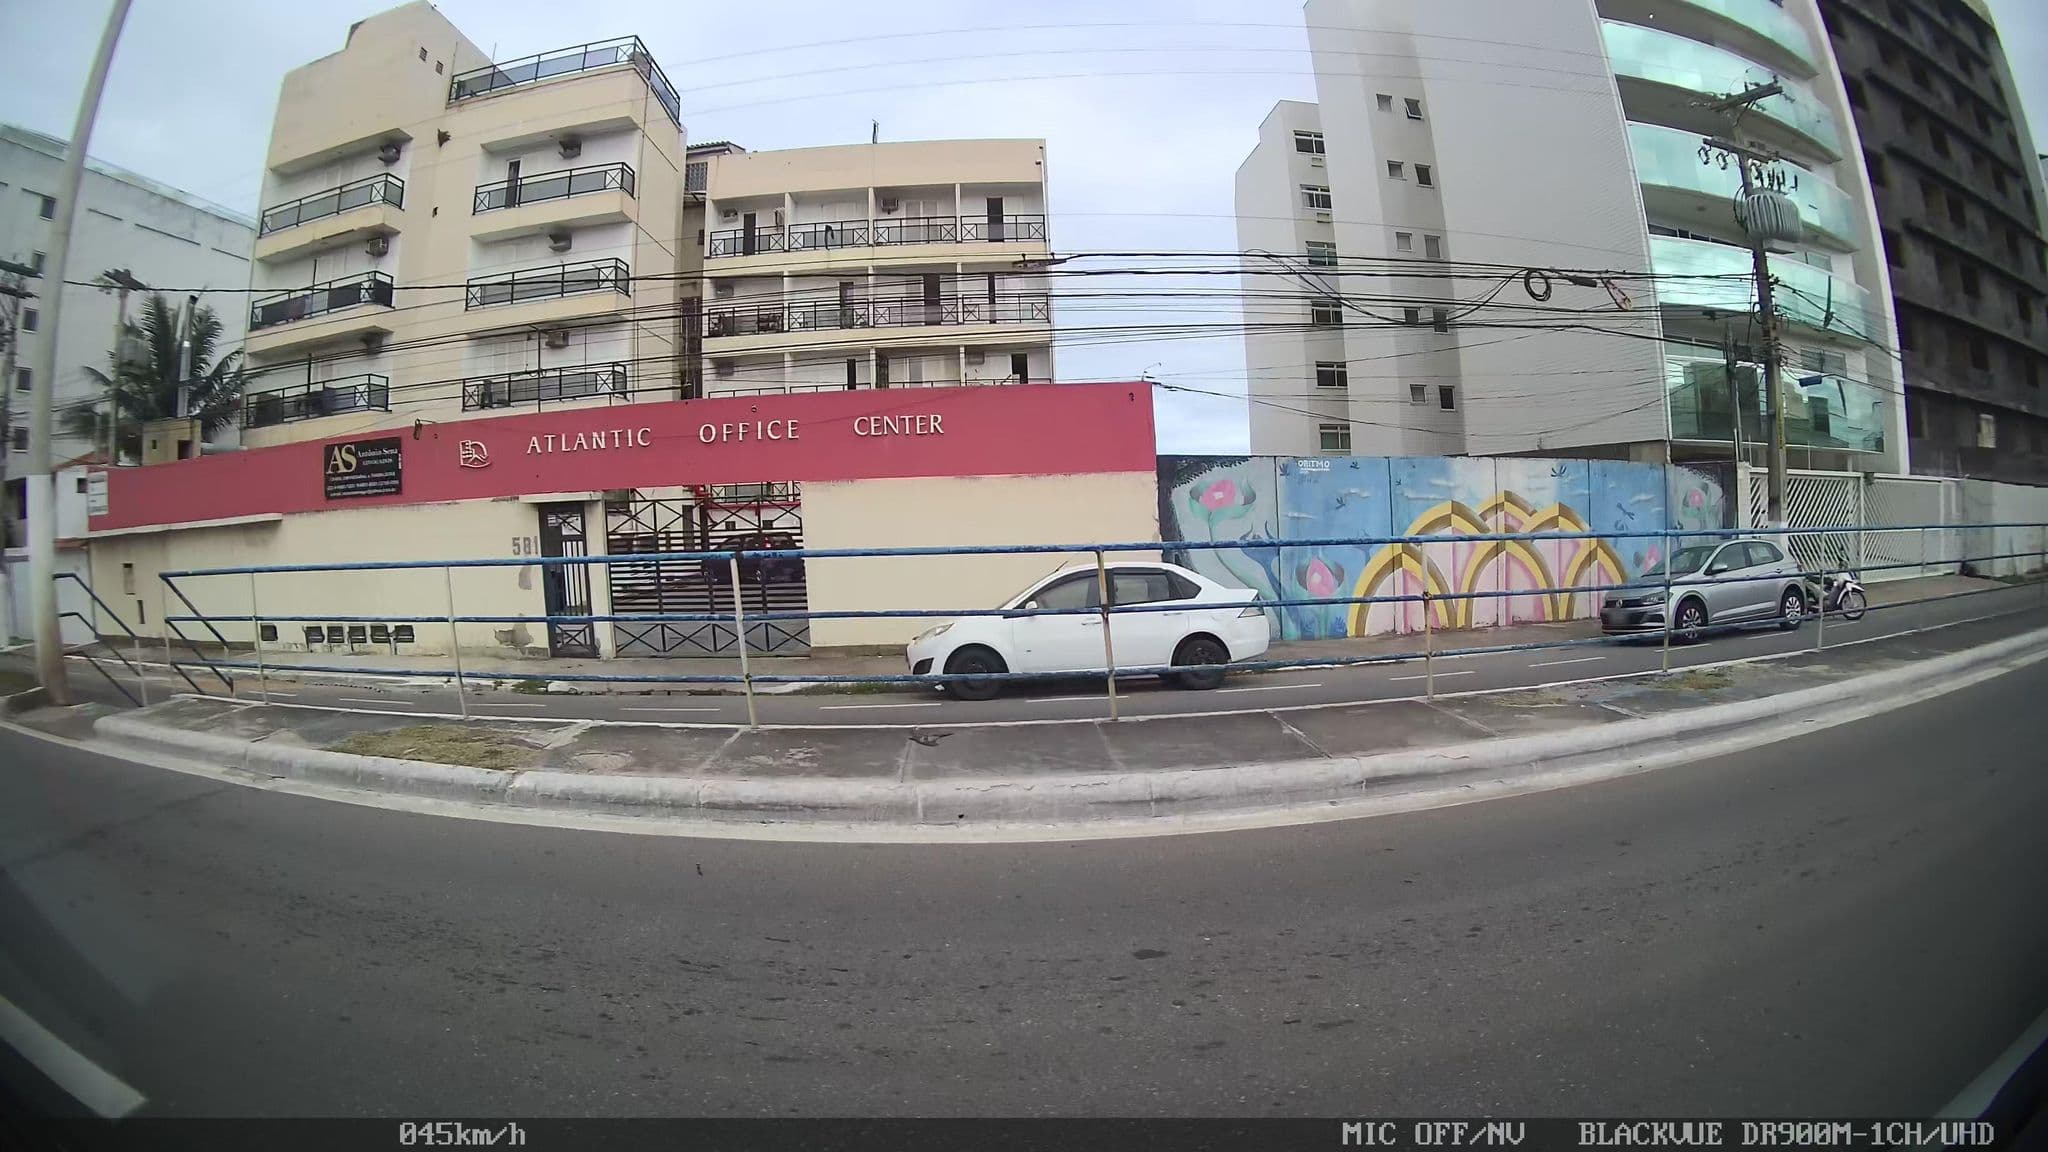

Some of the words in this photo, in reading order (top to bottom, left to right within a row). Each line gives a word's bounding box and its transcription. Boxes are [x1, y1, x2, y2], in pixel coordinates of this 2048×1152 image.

[526, 427, 651, 454] ATLANTIC
[699, 419, 800, 443] OFFICE
[853, 414, 945, 436] CENTER
[326, 444, 357, 474] AS
[511, 535, 539, 556] 581
